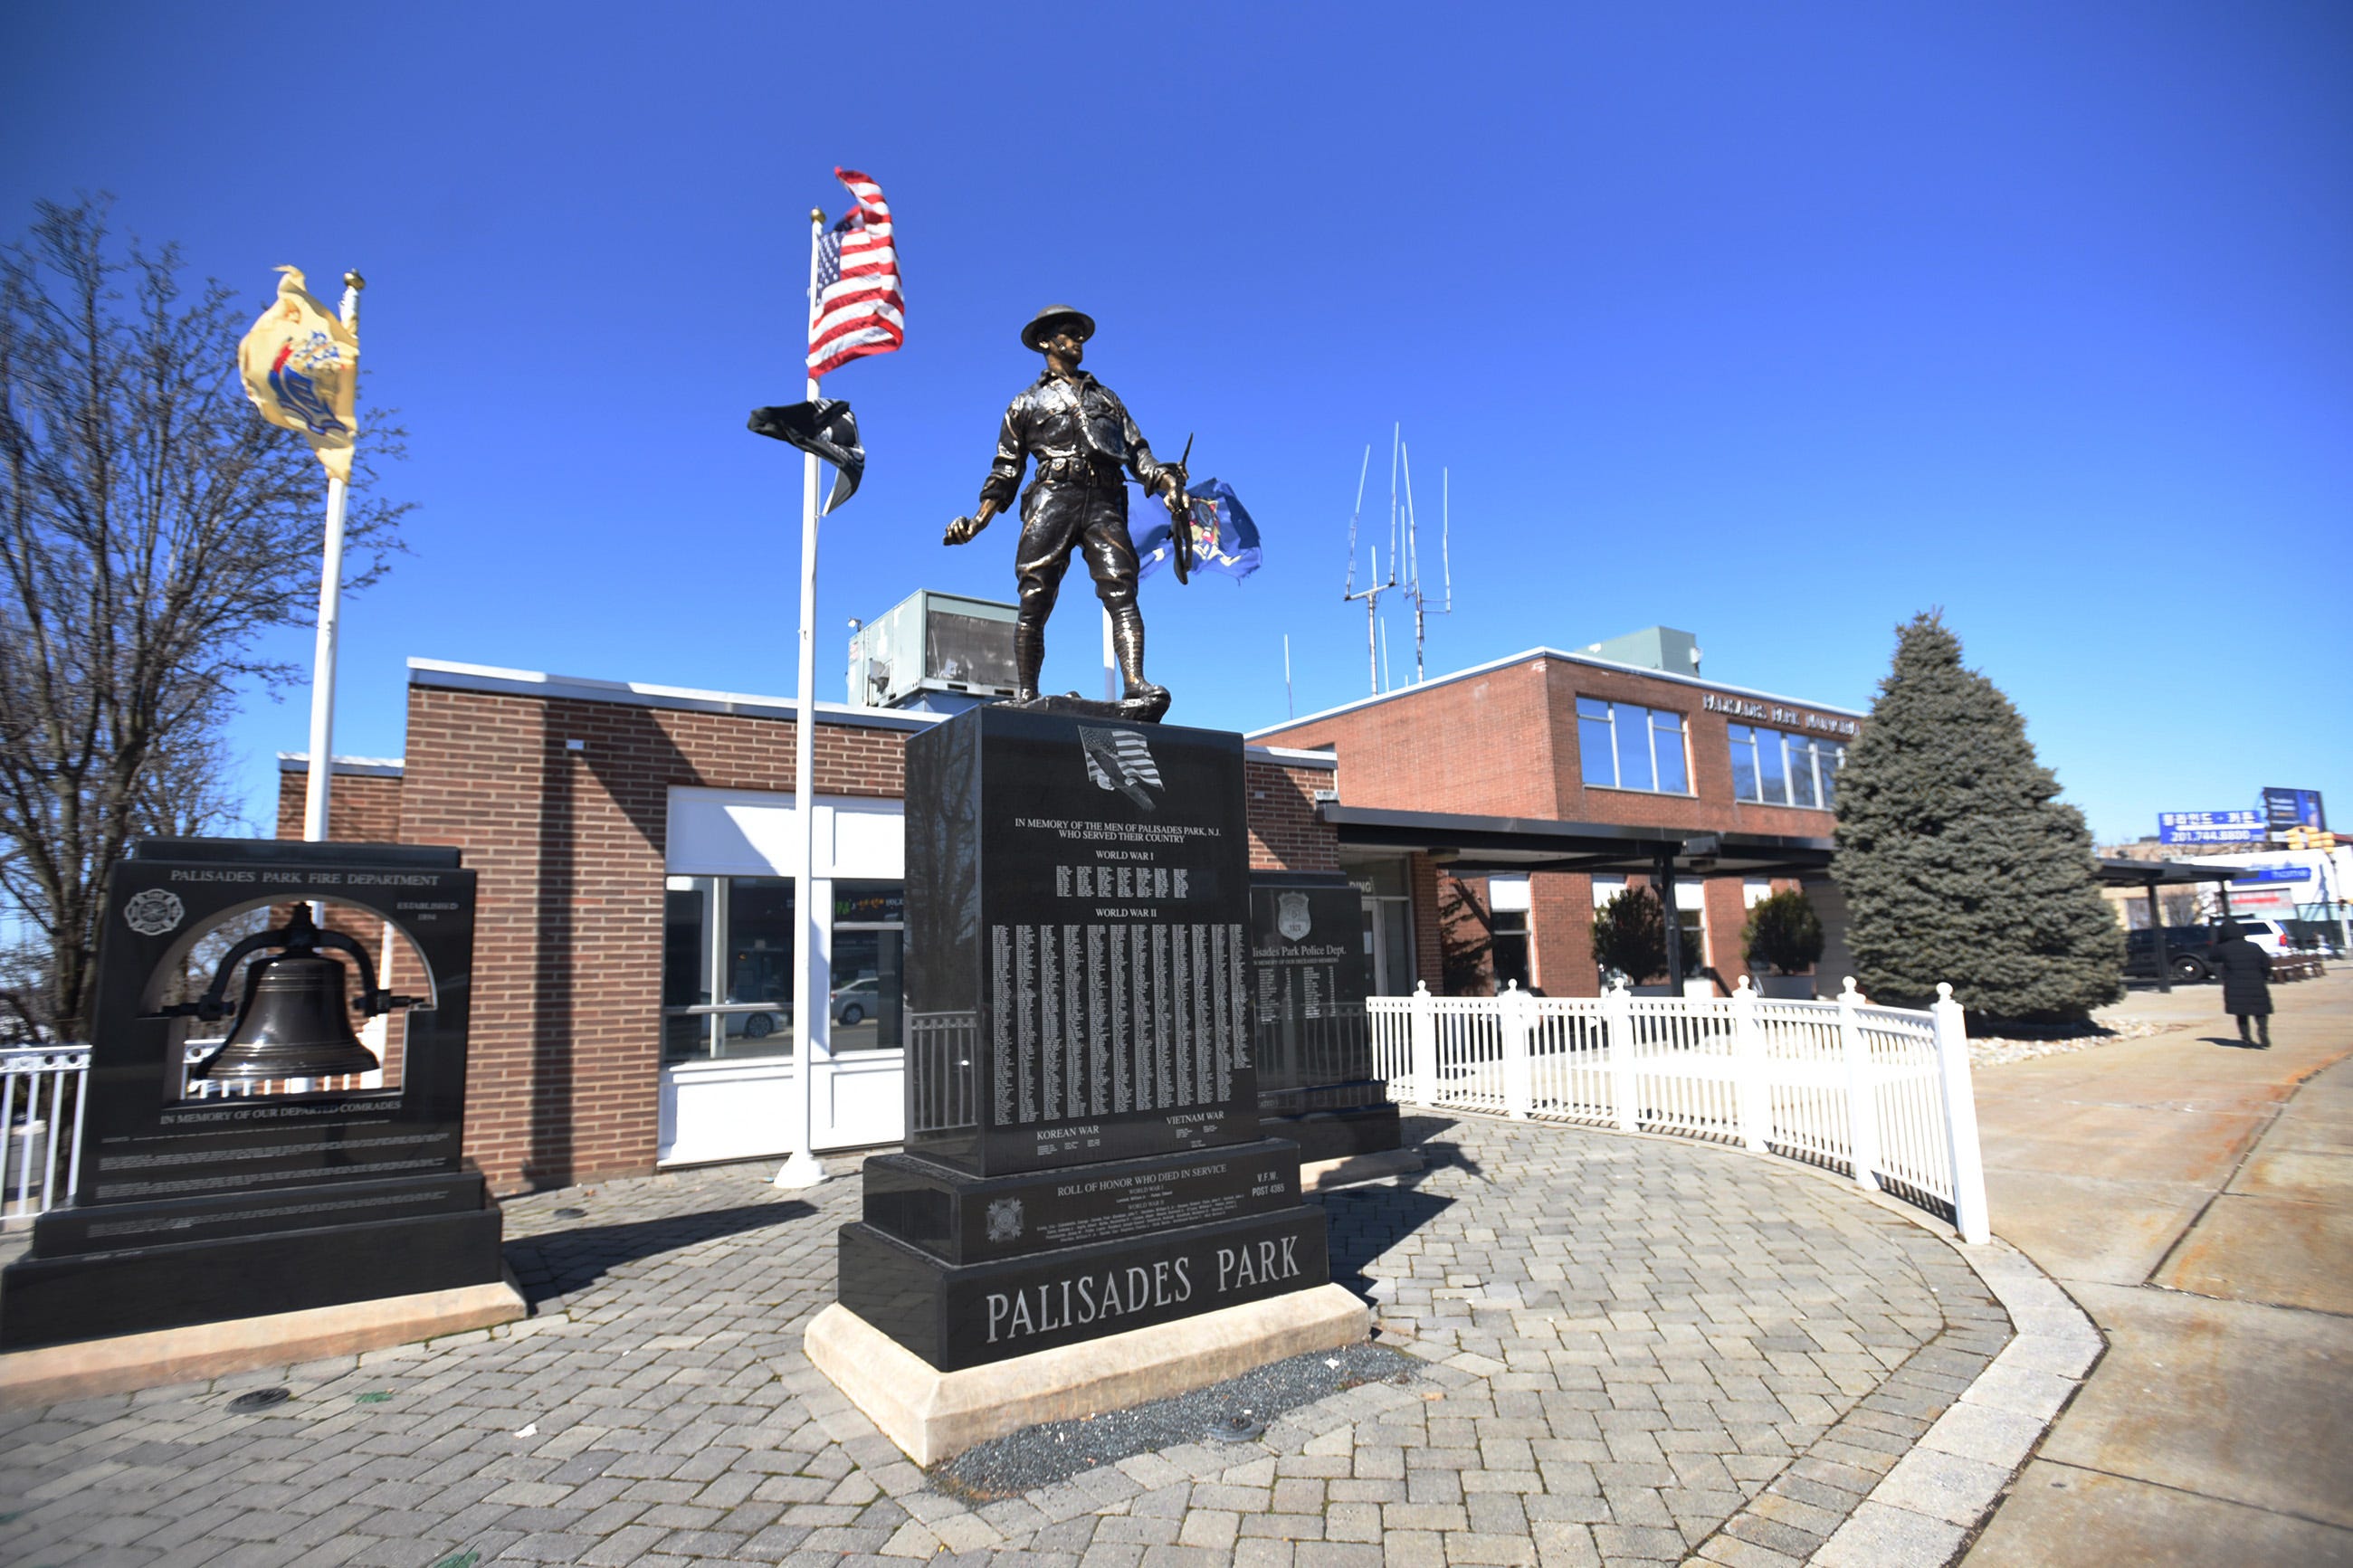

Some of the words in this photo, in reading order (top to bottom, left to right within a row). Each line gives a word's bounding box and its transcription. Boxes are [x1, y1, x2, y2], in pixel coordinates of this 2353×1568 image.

[1015, 818, 1025, 827] IN
[1028, 819, 1069, 830] MEMORY
[1071, 821, 1083, 830] OF
[1085, 822, 1102, 831] THE
[1104, 822, 1124, 832] MEN
[1125, 823, 1138, 832] OF
[1138, 824, 1183, 834] PALISADES
[1184, 826, 1207, 837] PARK,
[1208, 828, 1222, 837] N.J.
[1059, 830, 1081, 839] WHO
[1082, 831, 1117, 841] SERVED
[1118, 832, 1144, 842] THEIR
[1145, 833, 1186, 844] COUNTRY
[1096, 850, 1129, 860] WORLD
[1129, 851, 1150, 860] WAR
[170, 870, 256, 883] PALISADES
[262, 870, 303, 884] PARK
[309, 872, 341, 885] FIRE
[348, 873, 442, 887] DEPARTMENT
[1095, 908, 1129, 917] WORLD
[1130, 908, 1149, 917] WAR
[1150, 908, 1157, 917] II
[1253, 946, 1281, 958] lisades
[1281, 946, 1300, 957] Park
[1300, 945, 1325, 956] Police
[1327, 945, 1347, 959] Dept.
[160, 1115, 176, 1125] IN
[176, 1112, 231, 1124] MEMORY
[233, 1109, 251, 1120] OF
[252, 1107, 279, 1118] OUR
[280, 1104, 338, 1117] DEPARTED
[339, 1100, 403, 1113] COMRADES
[1166, 1113, 1205, 1126] VIETNAM
[1206, 1111, 1224, 1121] WAR
[1036, 1126, 1077, 1141] KOREAN
[1078, 1125, 1100, 1136] WAR
[1057, 1183, 1083, 1196] ROLL
[1084, 1182, 1098, 1193] OF
[1100, 1178, 1132, 1191] HONOR
[1135, 1174, 1157, 1185] WHO
[1158, 1171, 1179, 1183] DIED
[1181, 1169, 1191, 1179] IN
[1192, 1164, 1227, 1177] SERVICE
[1257, 1172, 1278, 1183] V.F.W.
[1252, 1185, 1269, 1197] POST
[986, 1257, 1192, 1344] PALISADES
[1216, 1235, 1300, 1293] PARK
